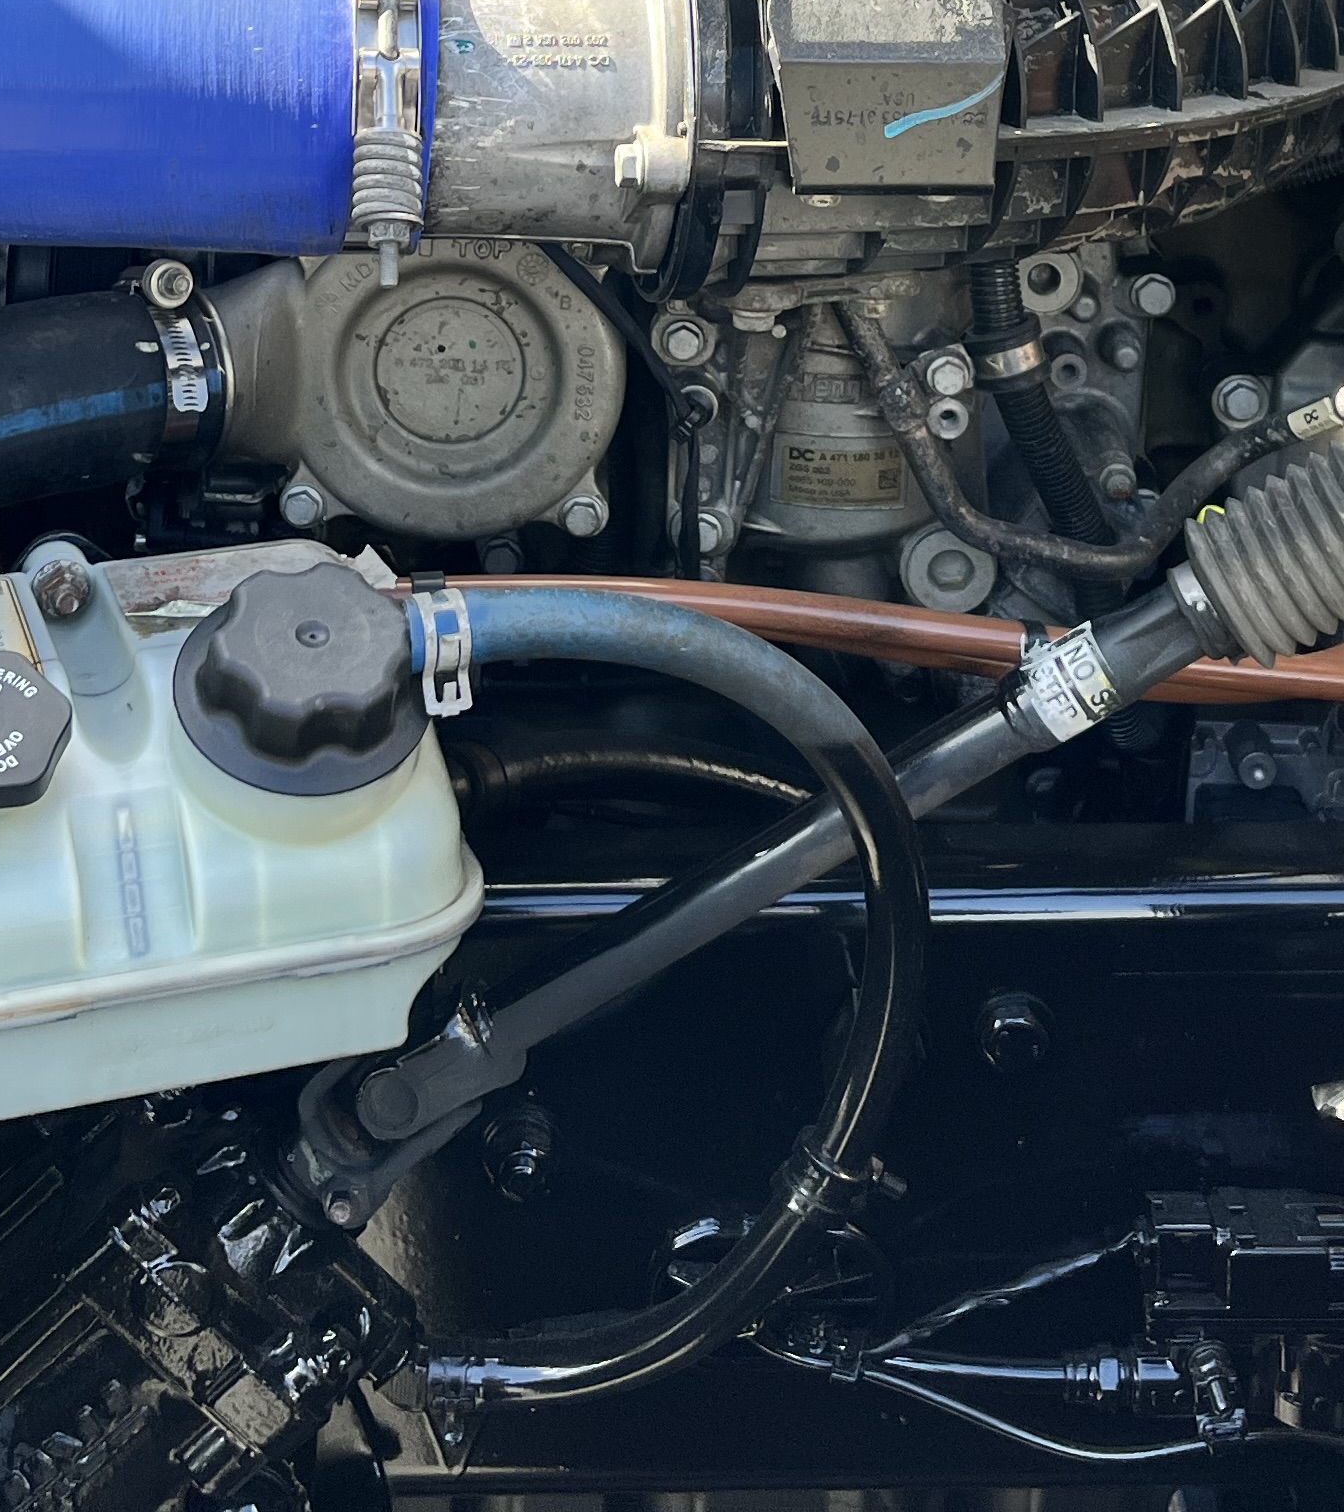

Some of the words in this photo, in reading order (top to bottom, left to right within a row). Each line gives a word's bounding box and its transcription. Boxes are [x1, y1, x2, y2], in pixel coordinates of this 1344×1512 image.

[456, 238, 512, 260] TOP
[1304, 409, 1320, 424] DC
[789, 447, 815, 462] DC
[819, 453, 827, 461] A
[829, 453, 848, 462] 471
[1063, 643, 1095, 681] NO
